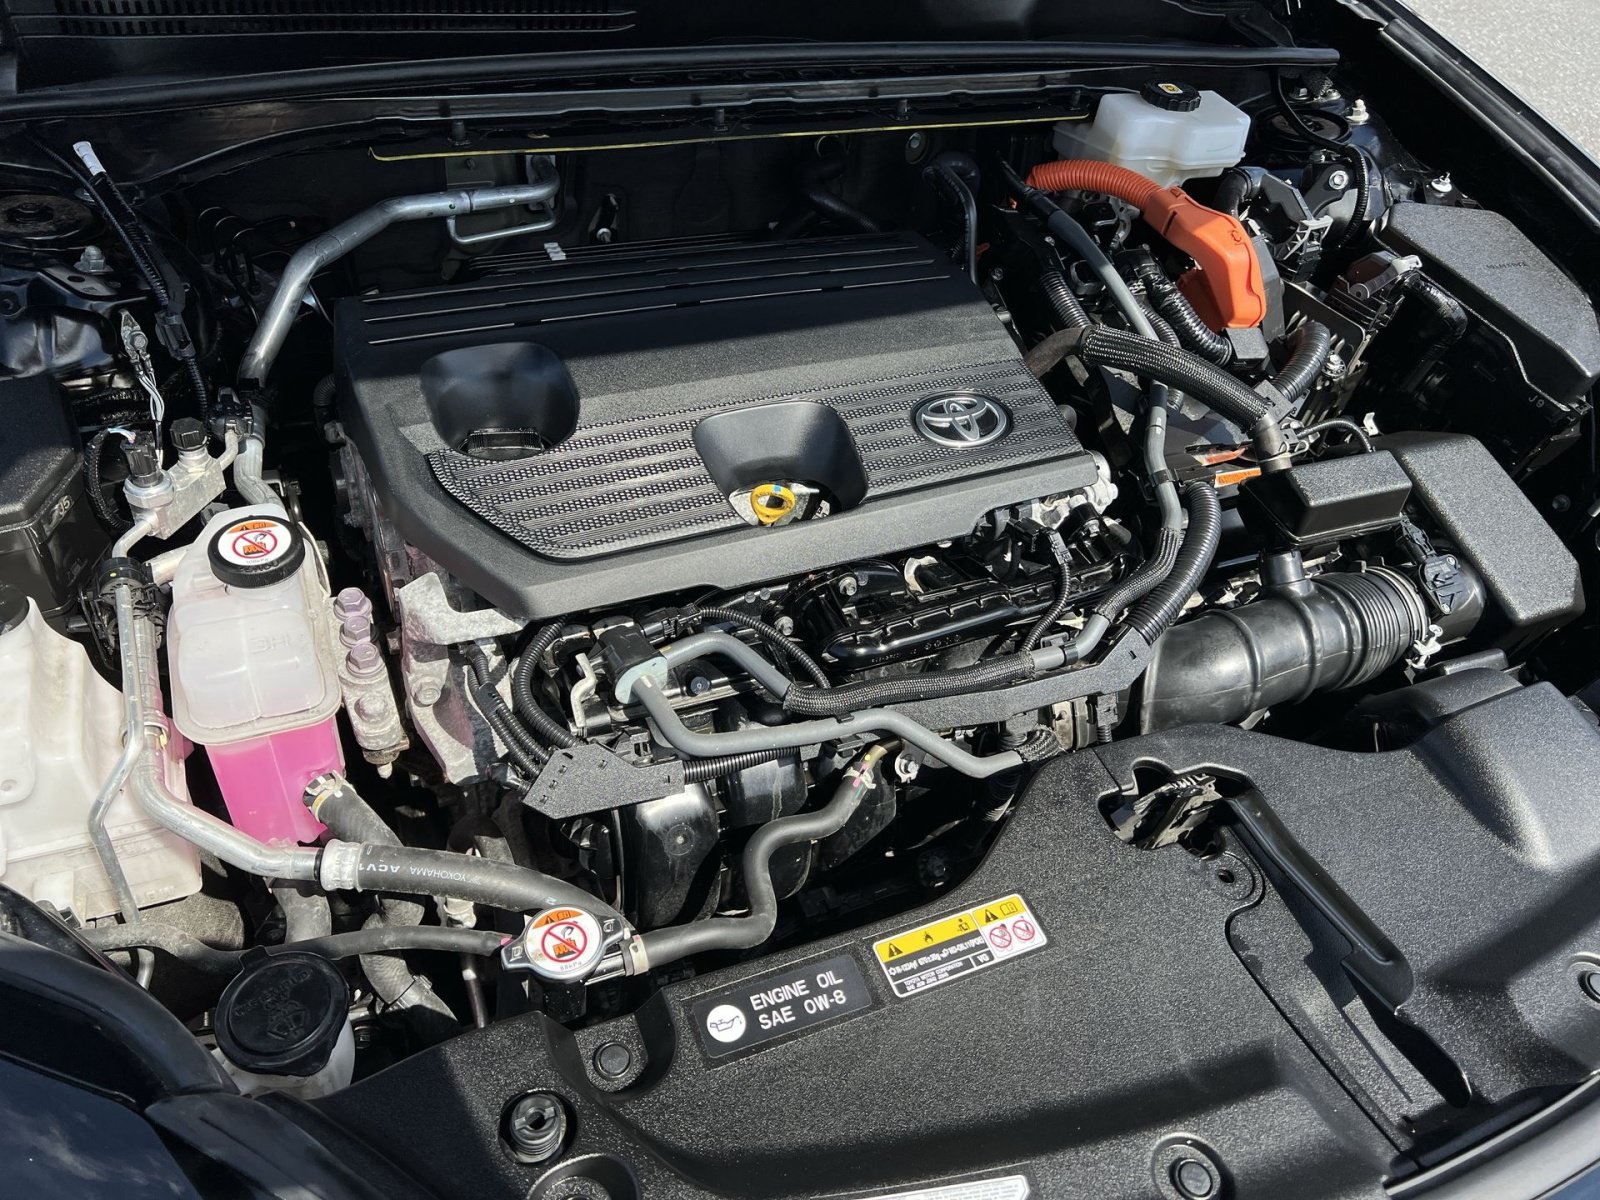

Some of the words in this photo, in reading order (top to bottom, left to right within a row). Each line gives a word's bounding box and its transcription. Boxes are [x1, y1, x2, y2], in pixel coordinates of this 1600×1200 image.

[409, 866, 466, 882] YOKOHAMA
[750, 979, 810, 1011] ENGINE
[816, 970, 844, 989] OIL
[758, 1005, 796, 1030] SAE
[803, 989, 847, 1014] 0W-8
